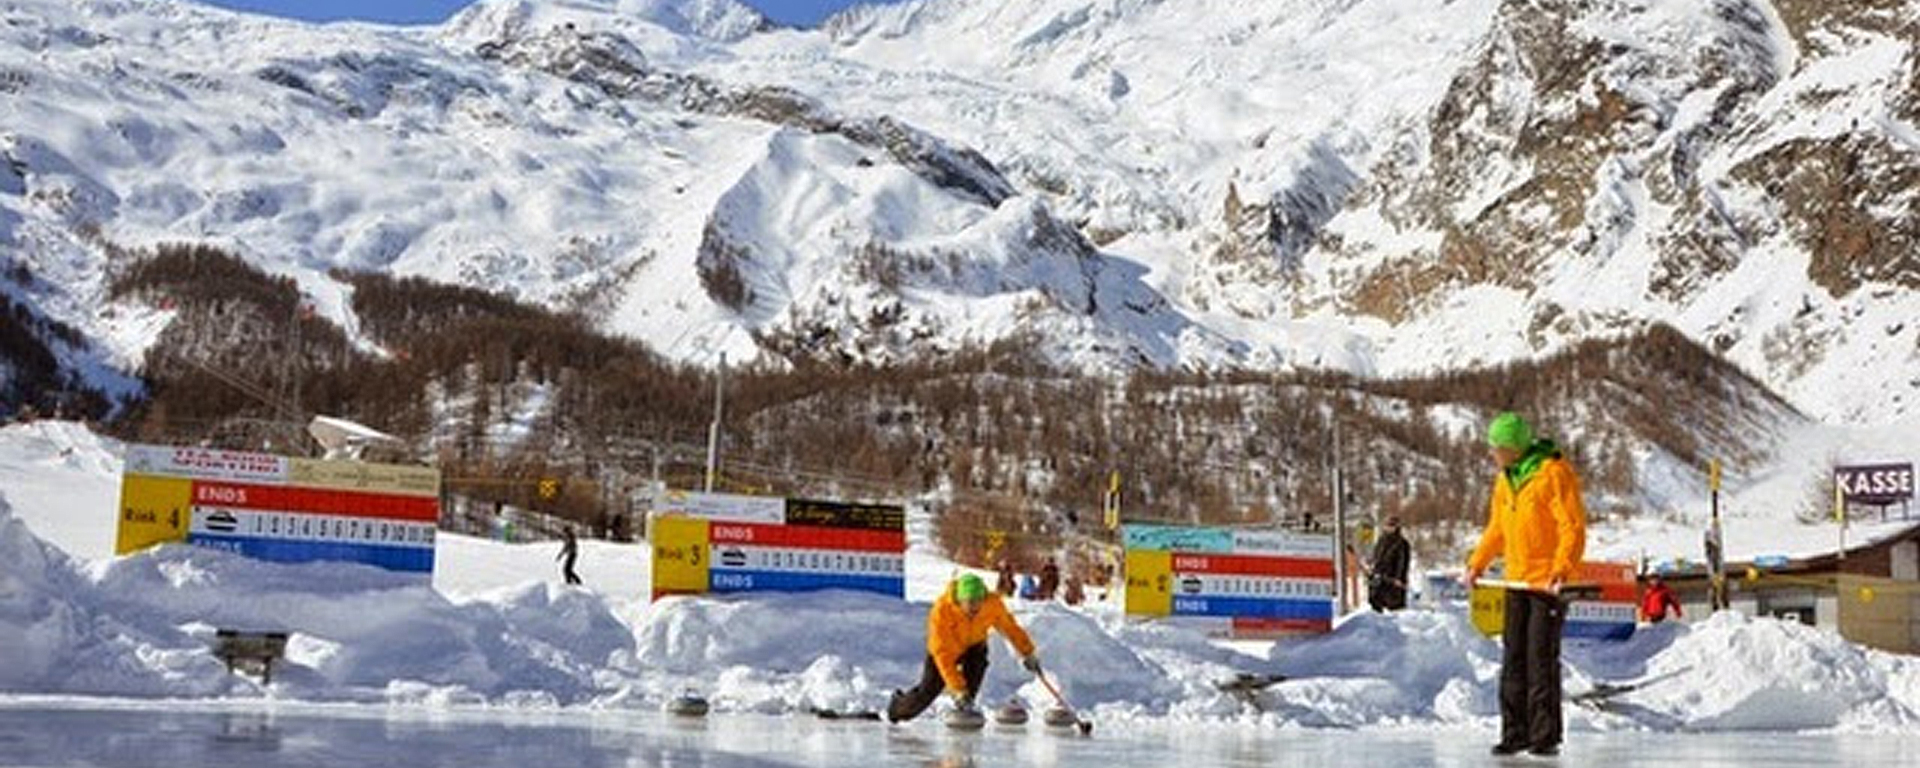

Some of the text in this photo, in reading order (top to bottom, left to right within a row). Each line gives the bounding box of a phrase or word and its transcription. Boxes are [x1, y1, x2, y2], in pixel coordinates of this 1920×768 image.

[1836, 471, 1911, 494] KASSE
[197, 486, 247, 503] ENDS
[125, 507, 180, 529] Rink 4
[713, 526, 754, 540] ENDS
[1176, 557, 1208, 570] ENDS
[713, 574, 754, 588] ENDS
[1176, 601, 1208, 613] ENDS
